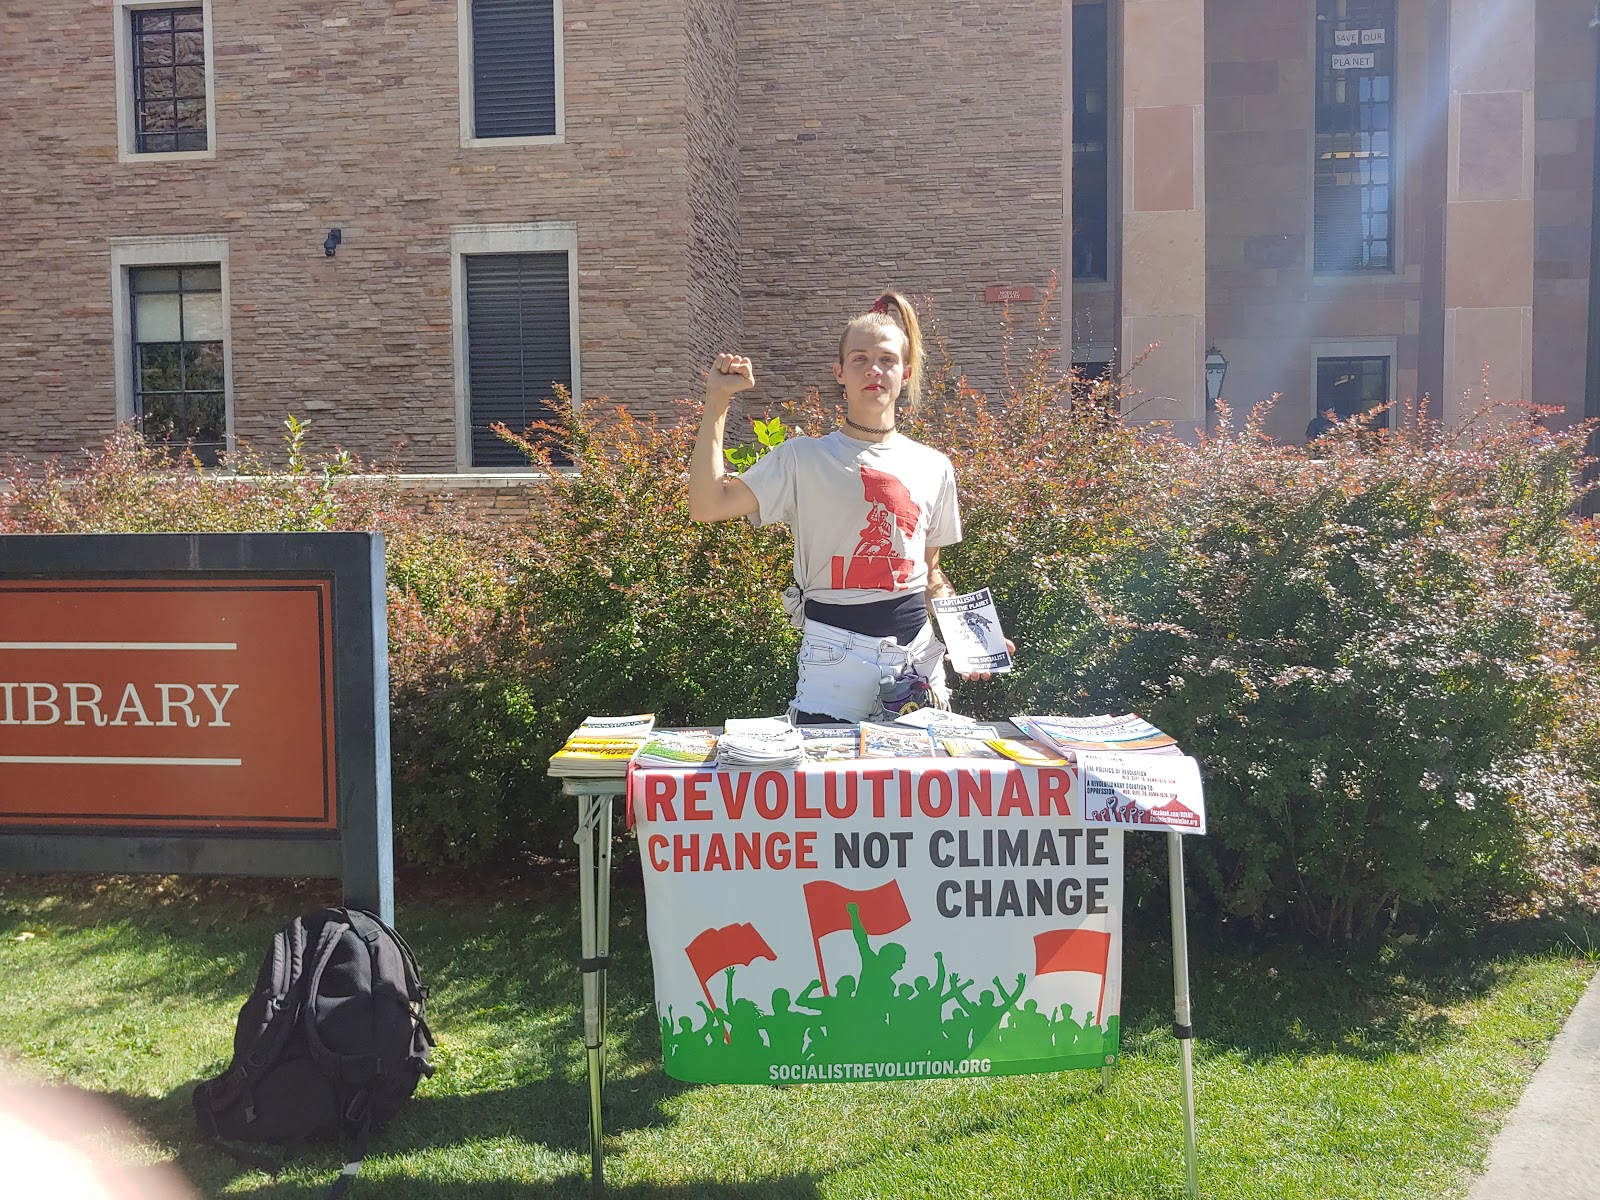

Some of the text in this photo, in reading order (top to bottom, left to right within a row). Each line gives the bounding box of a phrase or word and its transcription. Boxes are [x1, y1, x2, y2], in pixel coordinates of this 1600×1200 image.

[1336, 33, 1383, 42] SAVE OUR
[1333, 57, 1371, 67] PLANET
[939, 592, 983, 606] CAPITALISM IS
[969, 599, 989, 610] PLANET
[1086, 787, 1115, 795] OPPRESSION
[1126, 782, 1147, 791] SOLUTION
[645, 769, 1078, 822] REVOLUTIONAR
[649, 828, 1109, 872] CHANGE NOT CLIMATE
[936, 877, 1109, 918] CHANGE
[769, 1058, 991, 1080] SOCIALISTREVOLUTION.ORG
